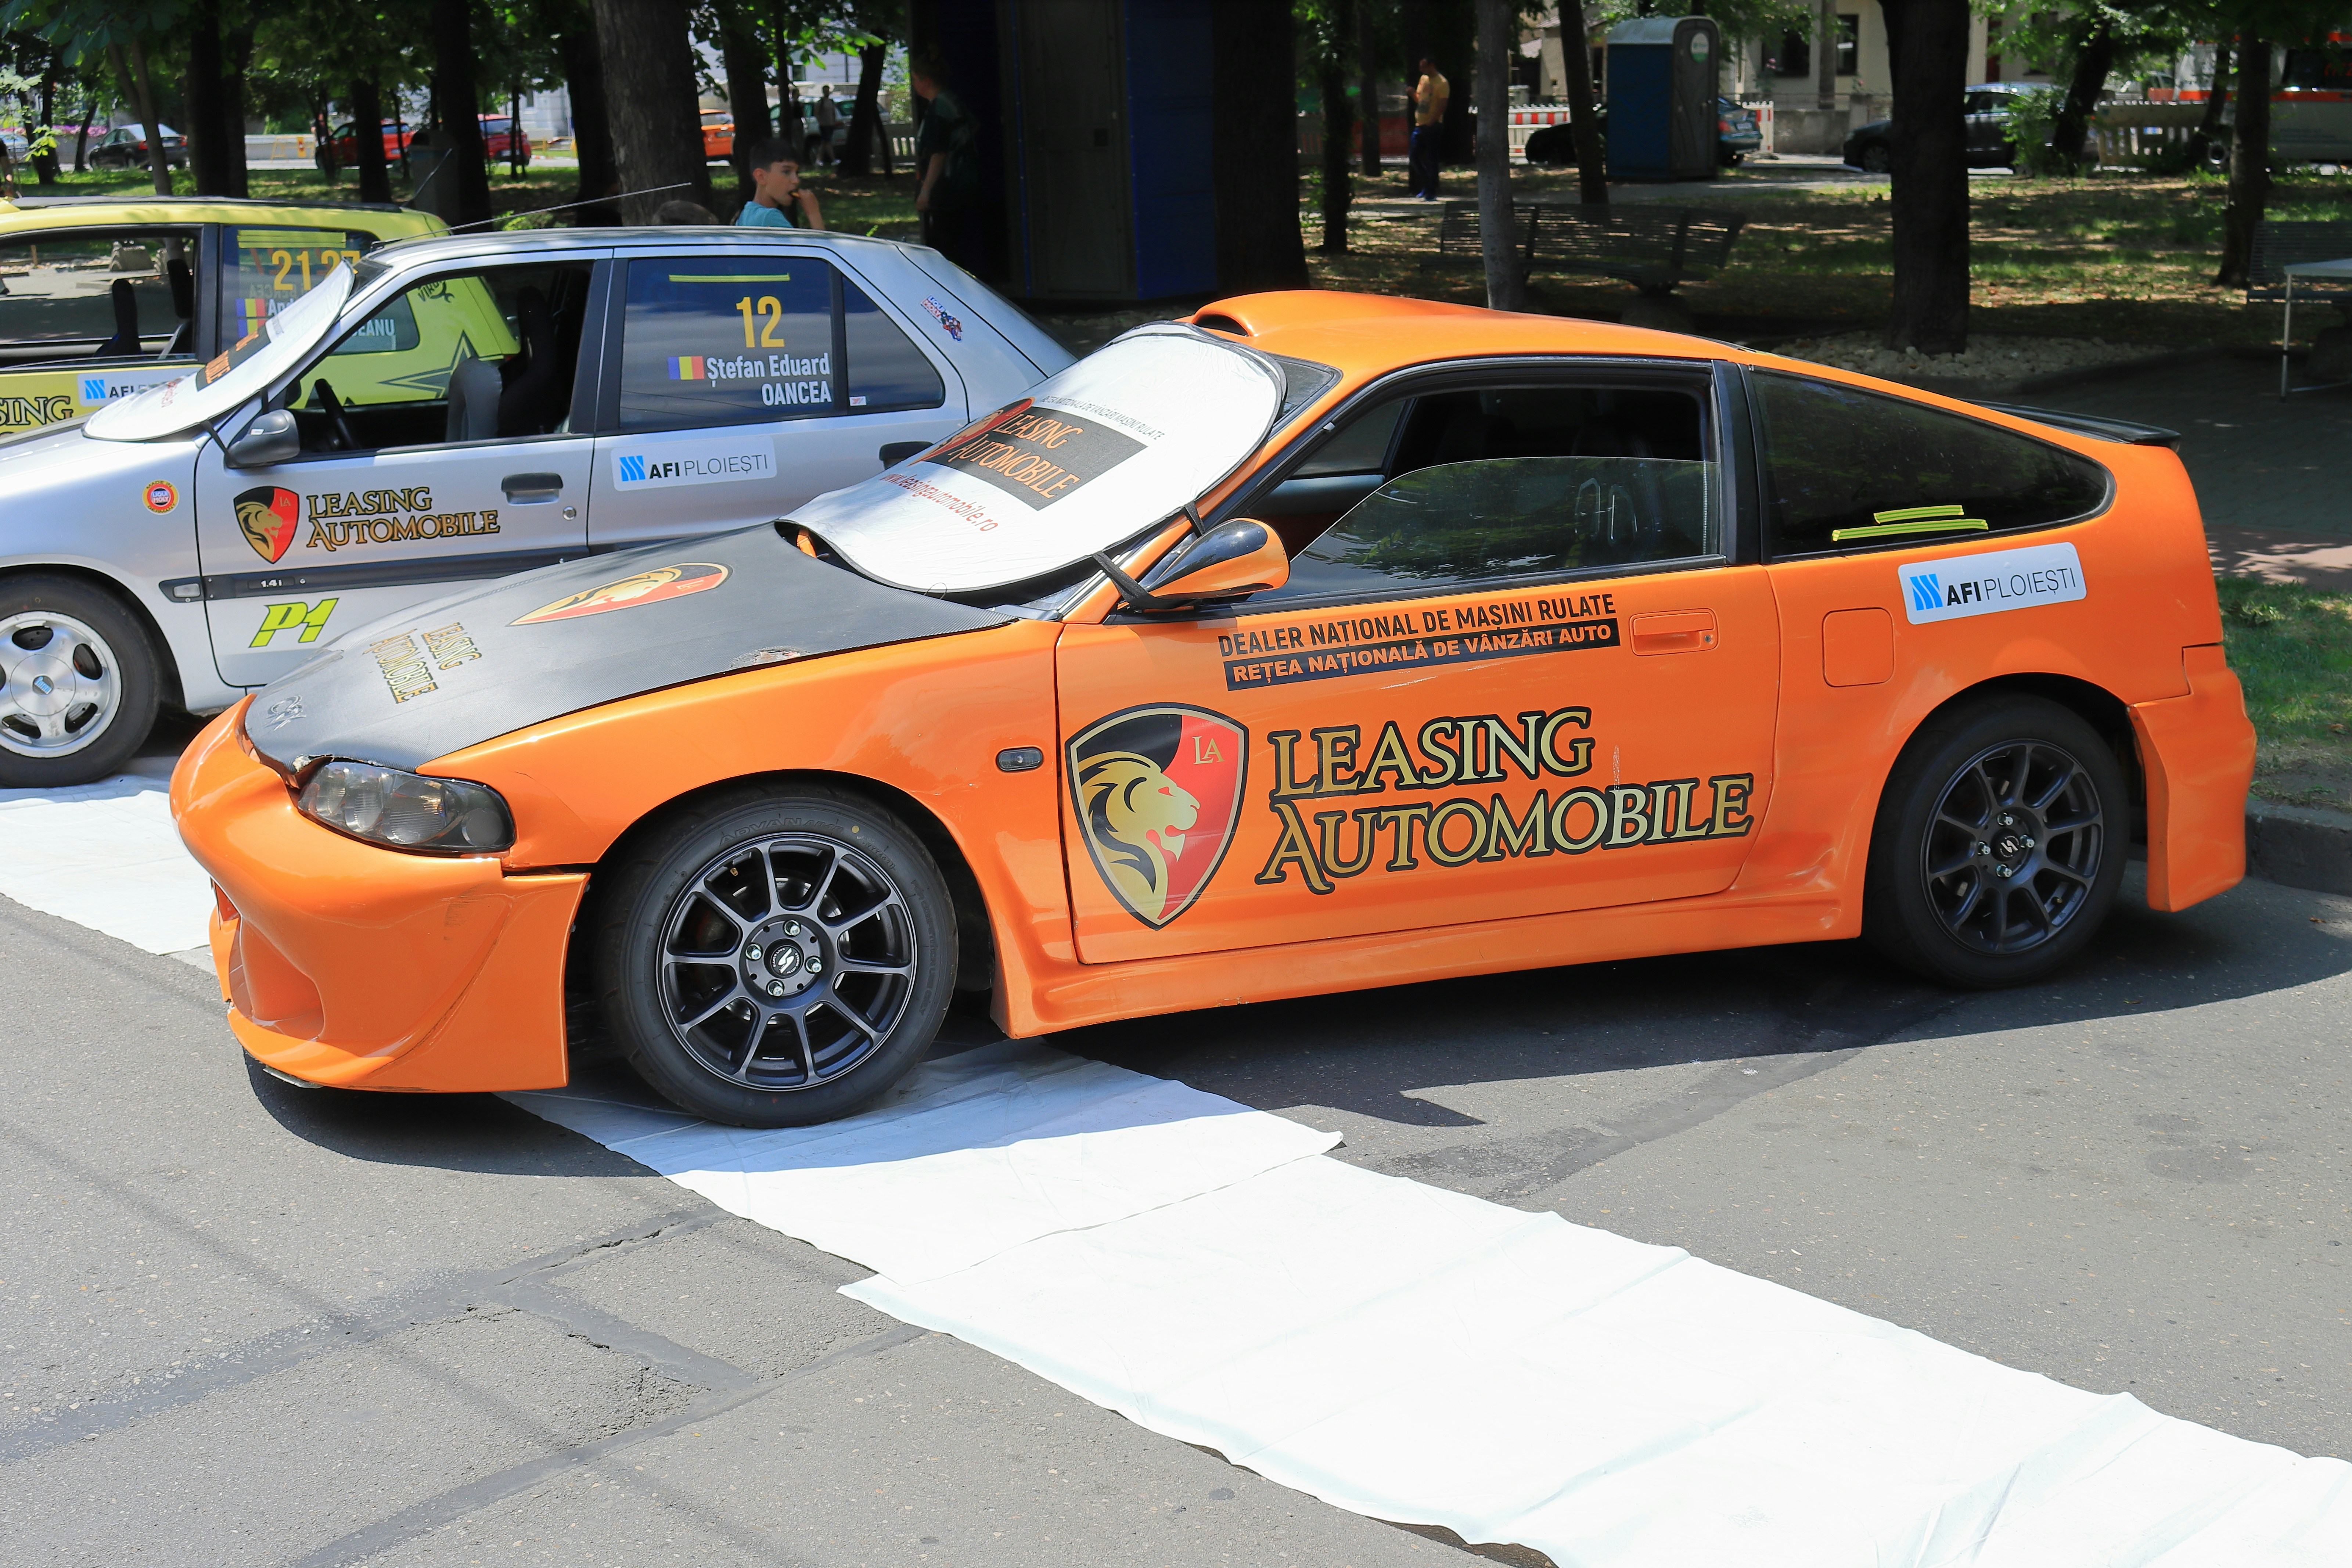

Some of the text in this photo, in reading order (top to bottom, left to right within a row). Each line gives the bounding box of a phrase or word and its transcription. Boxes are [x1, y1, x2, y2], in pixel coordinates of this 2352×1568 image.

[352, 318, 395, 337] EANU
[736, 295, 785, 348] 12
[706, 352, 830, 388] Ștefan Eduard
[761, 380, 832, 406] OANCEA
[992, 414, 1084, 449] LEASING
[1134, 423, 1165, 440] RULATE
[649, 454, 767, 479] AFI PLOIEȘTI
[947, 434, 1081, 499] AUTOMOBILE
[279, 497, 291, 508] LA
[306, 487, 432, 518] LEASING
[878, 474, 999, 532] www.leasingautomobile.ro
[306, 510, 501, 551] AUTOMOBILE
[1947, 567, 2076, 606] AFI PLOIEȘTI
[248, 597, 340, 648] P1
[1218, 627, 1304, 657] DEALER
[1422, 610, 1450, 633] DE
[1538, 593, 1616, 620] RULATE
[362, 628, 439, 704] AUTOMOBILE
[421, 622, 482, 670] LEASING
[1233, 625, 1611, 683] REȚEA NAȚIONALĂ DE VÂNZĂRI AUTO
[1192, 735, 1226, 766] LA
[1267, 705, 1593, 800] LEASING
[719, 817, 804, 845] ADVAN
[1254, 773, 1755, 896] AUTOMOBILE
